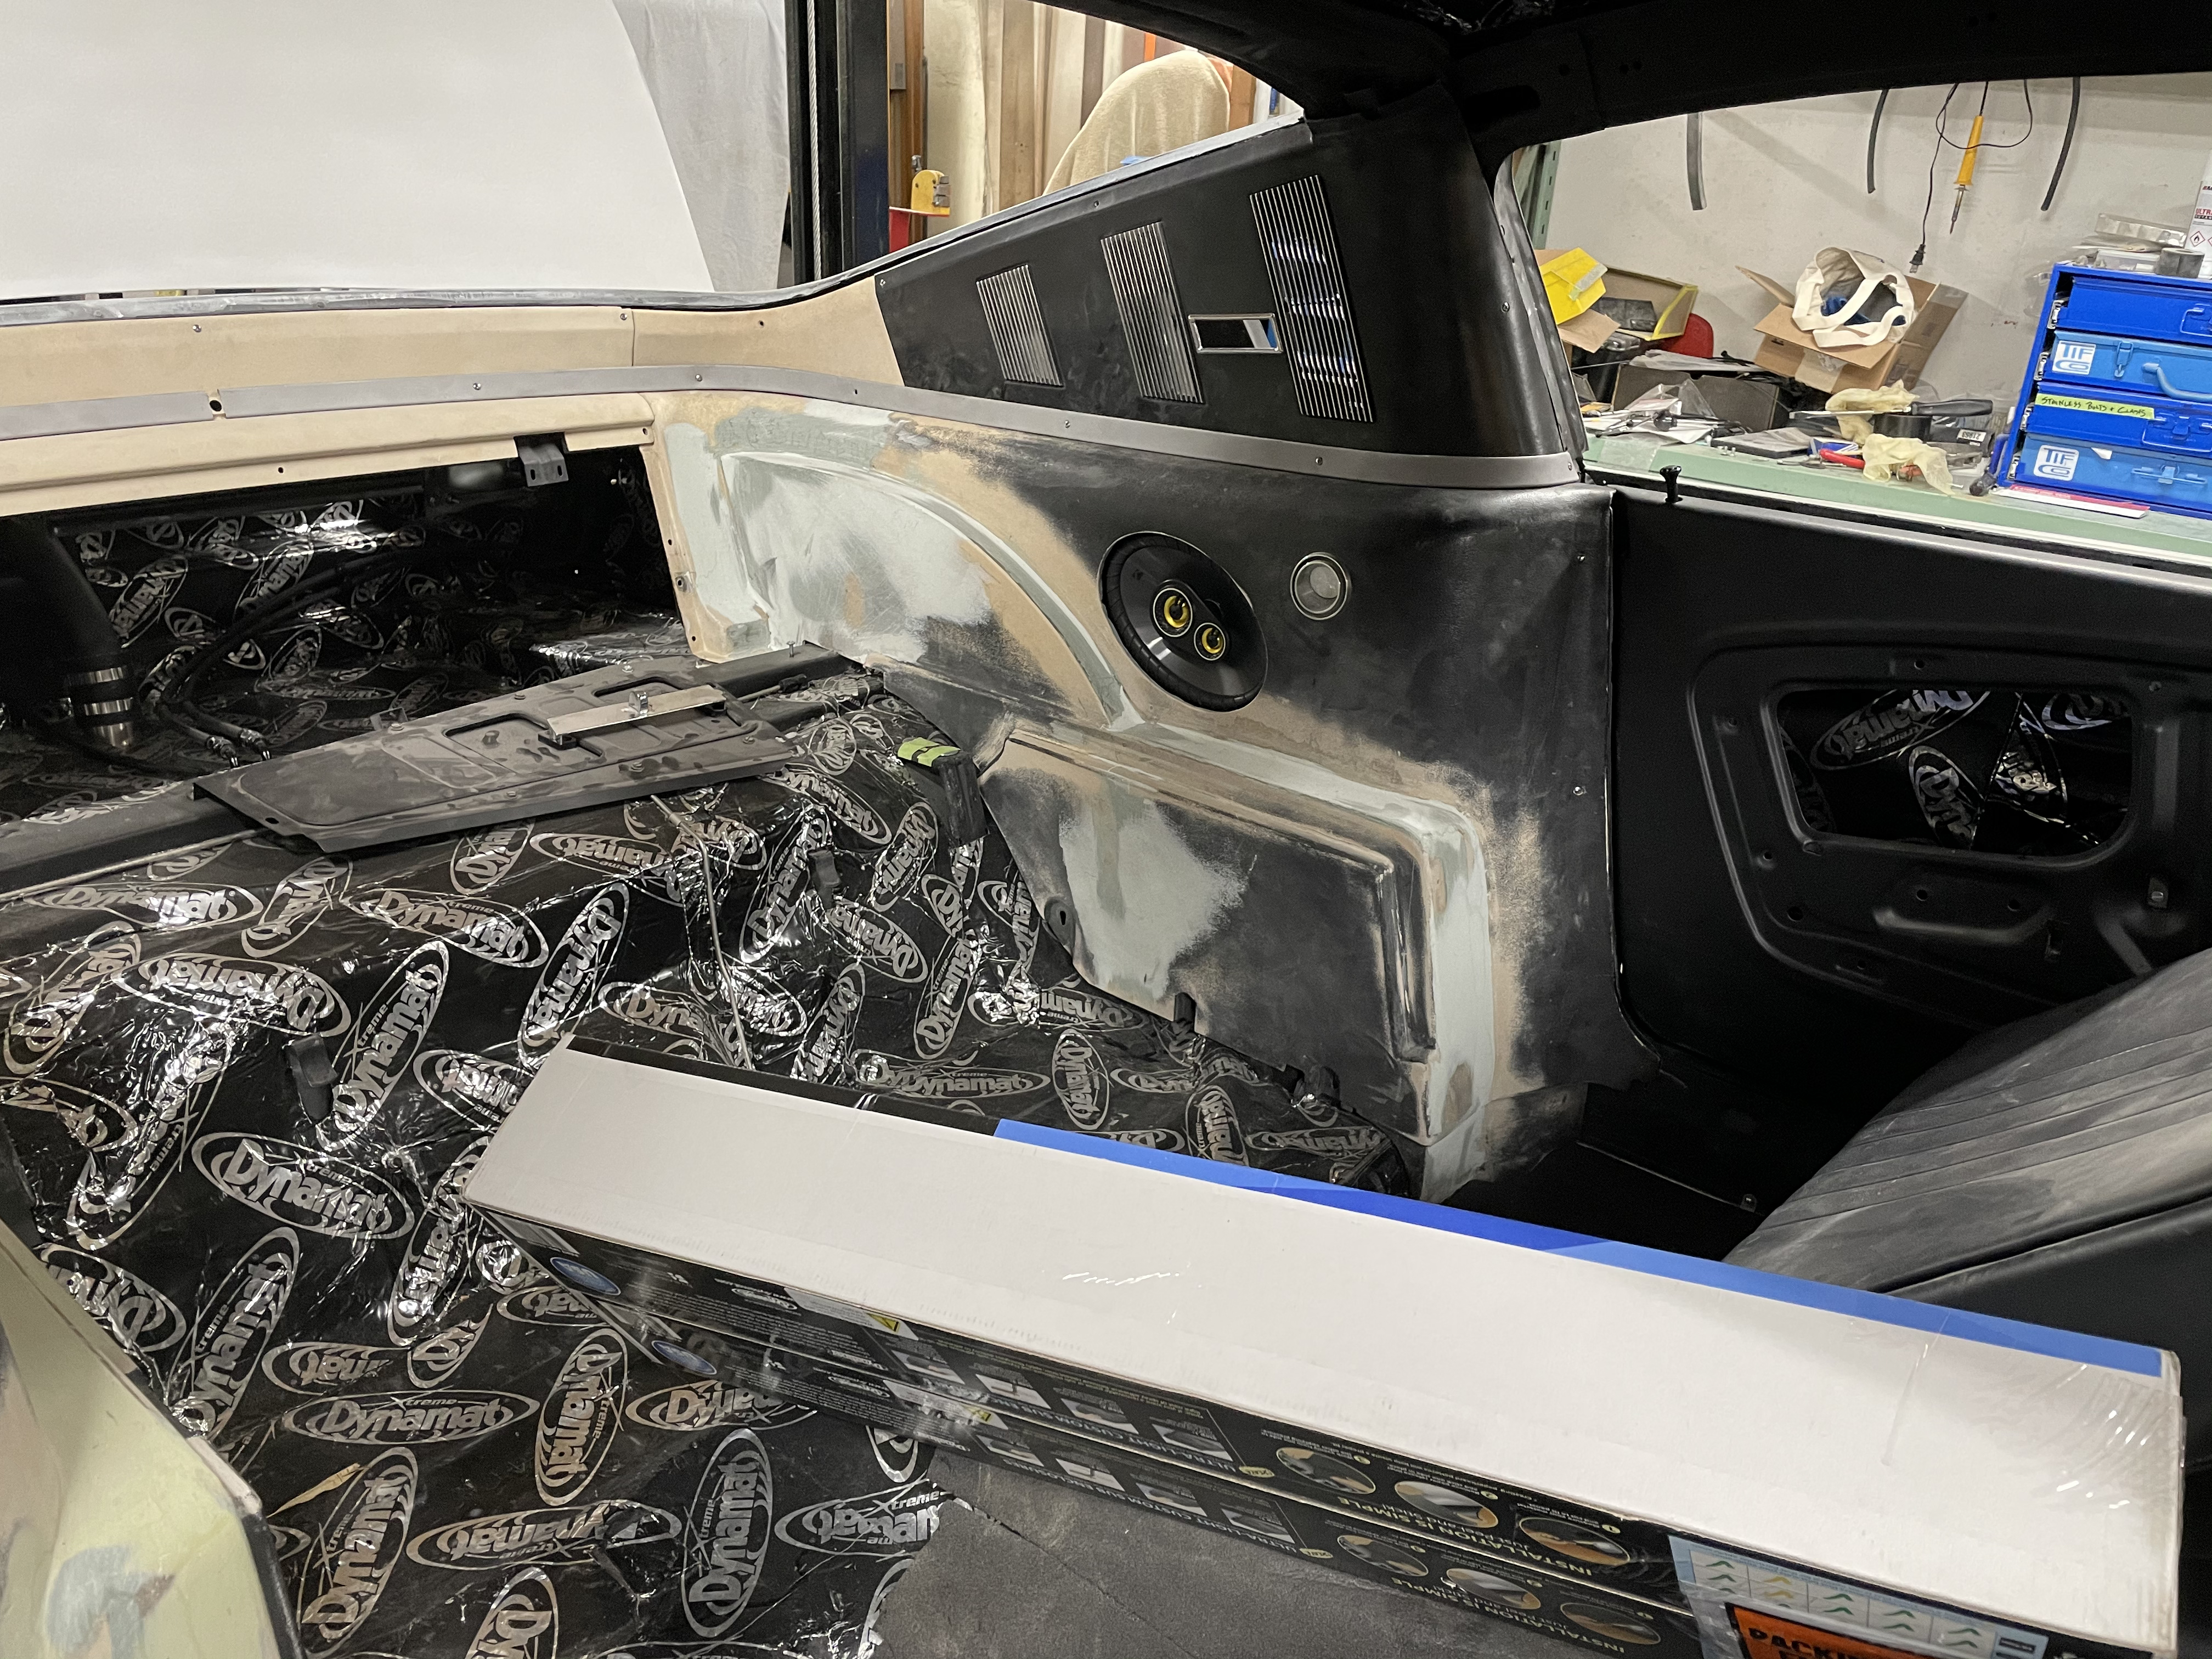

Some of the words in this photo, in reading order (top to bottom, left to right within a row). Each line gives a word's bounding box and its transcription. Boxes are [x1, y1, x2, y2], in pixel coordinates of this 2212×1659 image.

[566, 959, 605, 1012] Xtreme
[925, 957, 949, 1000] Xtreme
[346, 1001, 389, 1062] Xtreme
[1046, 1011, 1084, 1024] Xtreme
[1059, 1044, 1099, 1114] Dynamat
[222, 1137, 385, 1231] Dynamat
[183, 1300, 232, 1370] Xtreme
[322, 1397, 501, 1437] Dynamat
[393, 1397, 458, 1410] Xtreme
[545, 1348, 620, 1480] Dynamat
[591, 1392, 613, 1440] Xtreme
[689, 1458, 758, 1604] Dynamat
[691, 1497, 717, 1551] Xtreme
[1338, 1496, 1410, 1523] SIMPLE
[1415, 1519, 1434, 1530] IS
[303, 1477, 400, 1627] Dynamat
[315, 1511, 353, 1567] Xtreme
[1439, 1526, 1592, 1576] INSTALLATION
[1391, 1577, 1459, 1602] SIMPLE
[1463, 1599, 1480, 1609] IS
[1485, 1606, 1624, 1653] INSTALLATION
